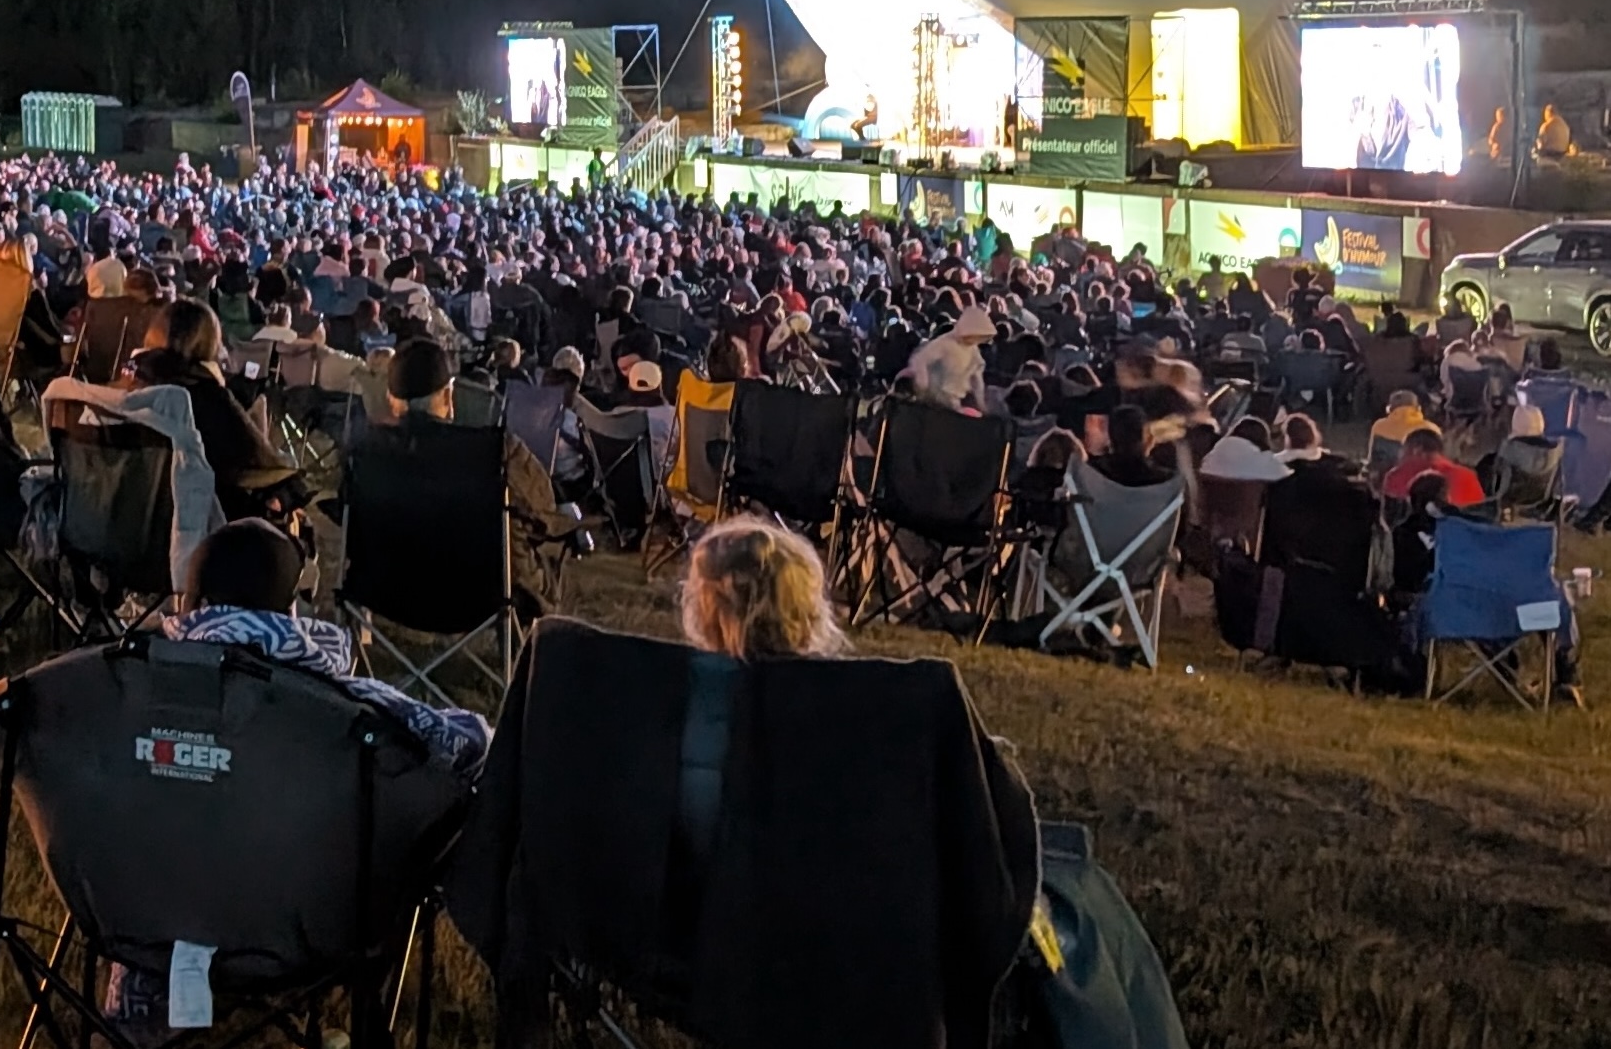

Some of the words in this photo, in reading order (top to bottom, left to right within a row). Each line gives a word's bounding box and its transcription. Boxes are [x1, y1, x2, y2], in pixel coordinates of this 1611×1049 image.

[1022, 137, 1082, 153] Présentateur
[1084, 139, 1118, 154] officiel
[1342, 228, 1380, 251] FESTIVAL
